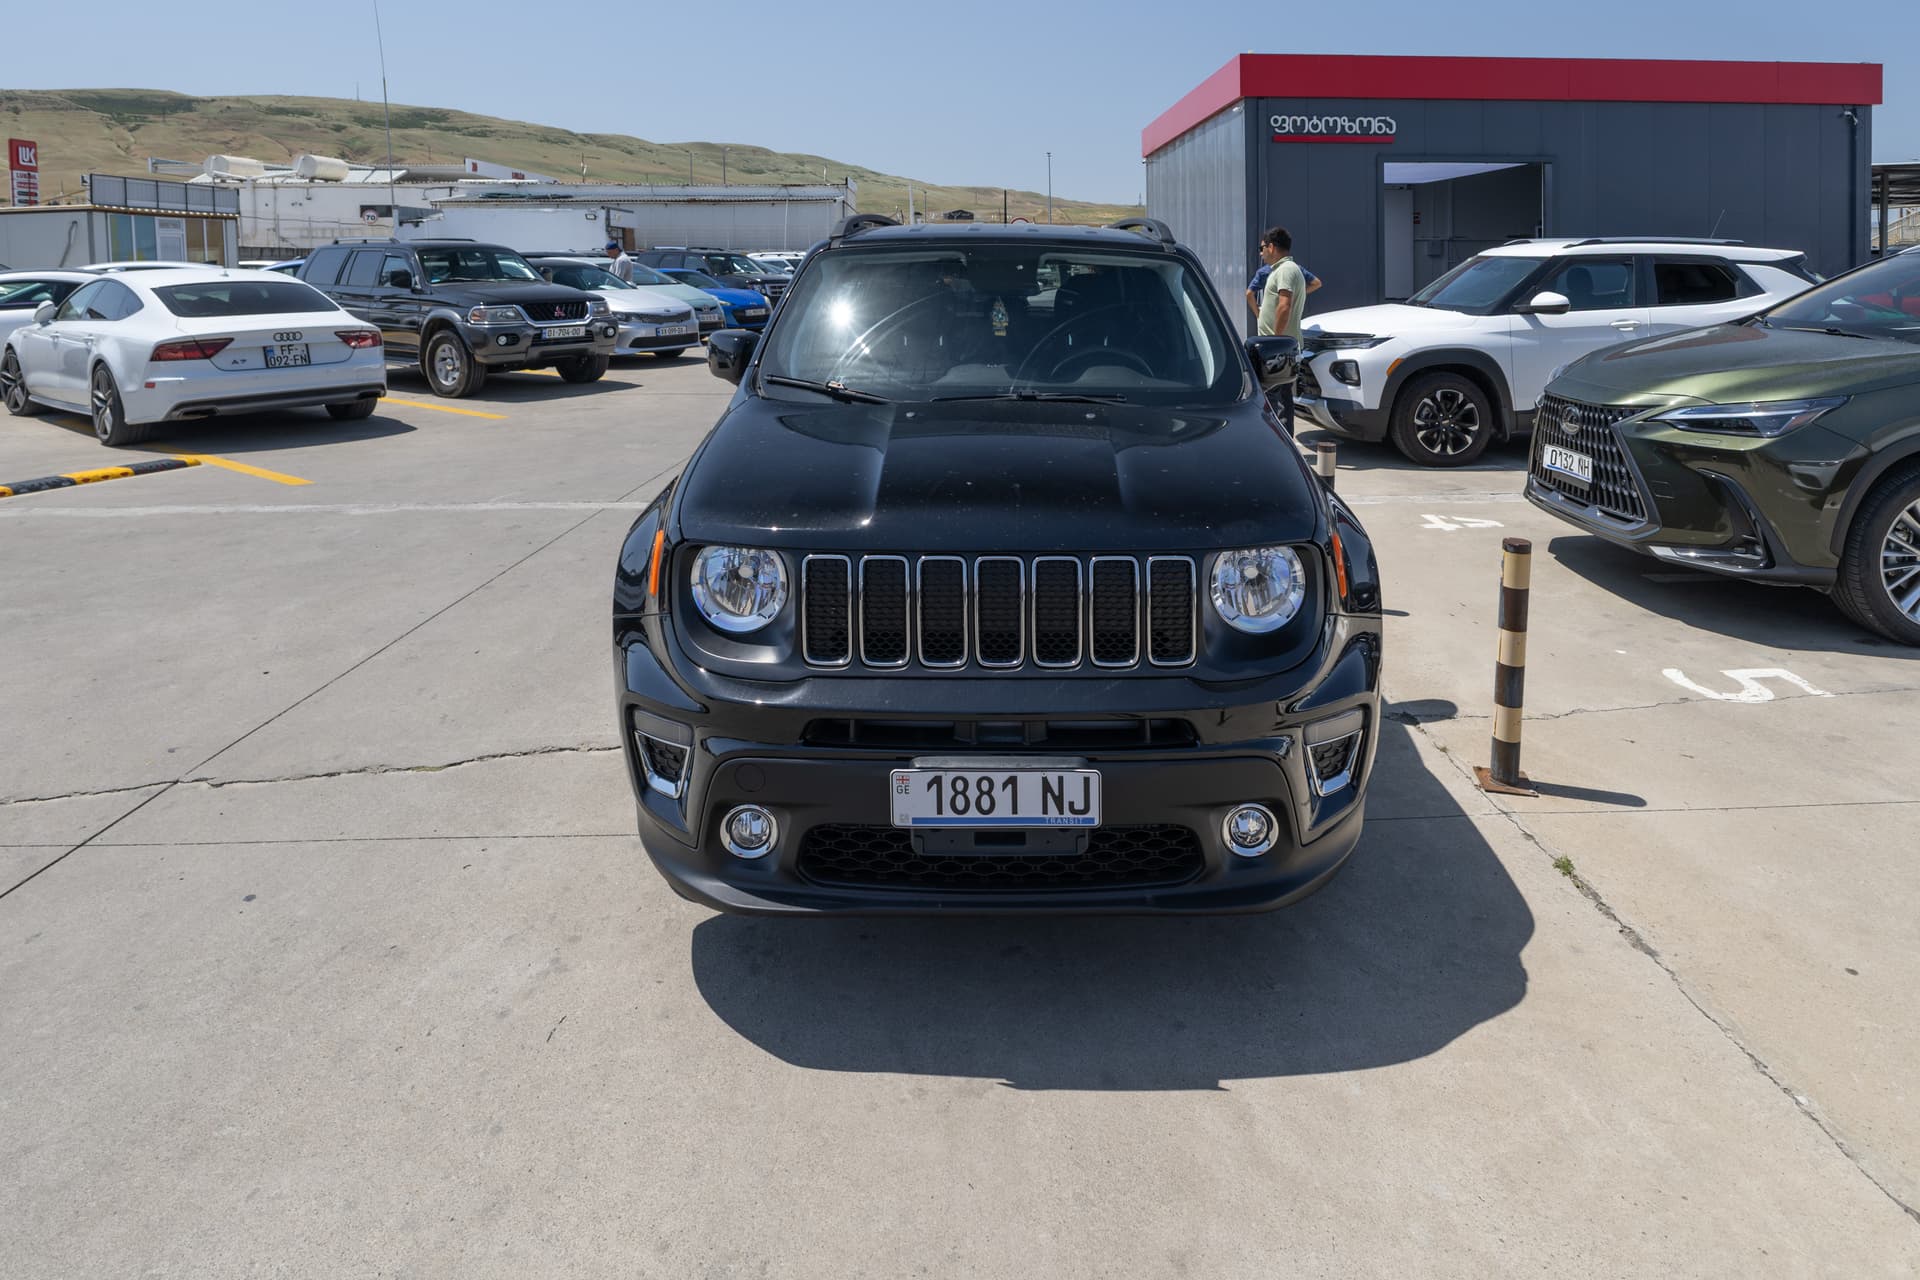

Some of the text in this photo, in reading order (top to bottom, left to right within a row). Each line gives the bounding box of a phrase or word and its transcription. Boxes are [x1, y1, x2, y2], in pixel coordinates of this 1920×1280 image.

[1270, 115, 1397, 134] ფოტოზონა
[1578, 457, 1590, 477] NH
[896, 785, 910, 795] GE
[926, 775, 1091, 816] 1881 NJ
[1045, 816, 1083, 825] TRANSIT
